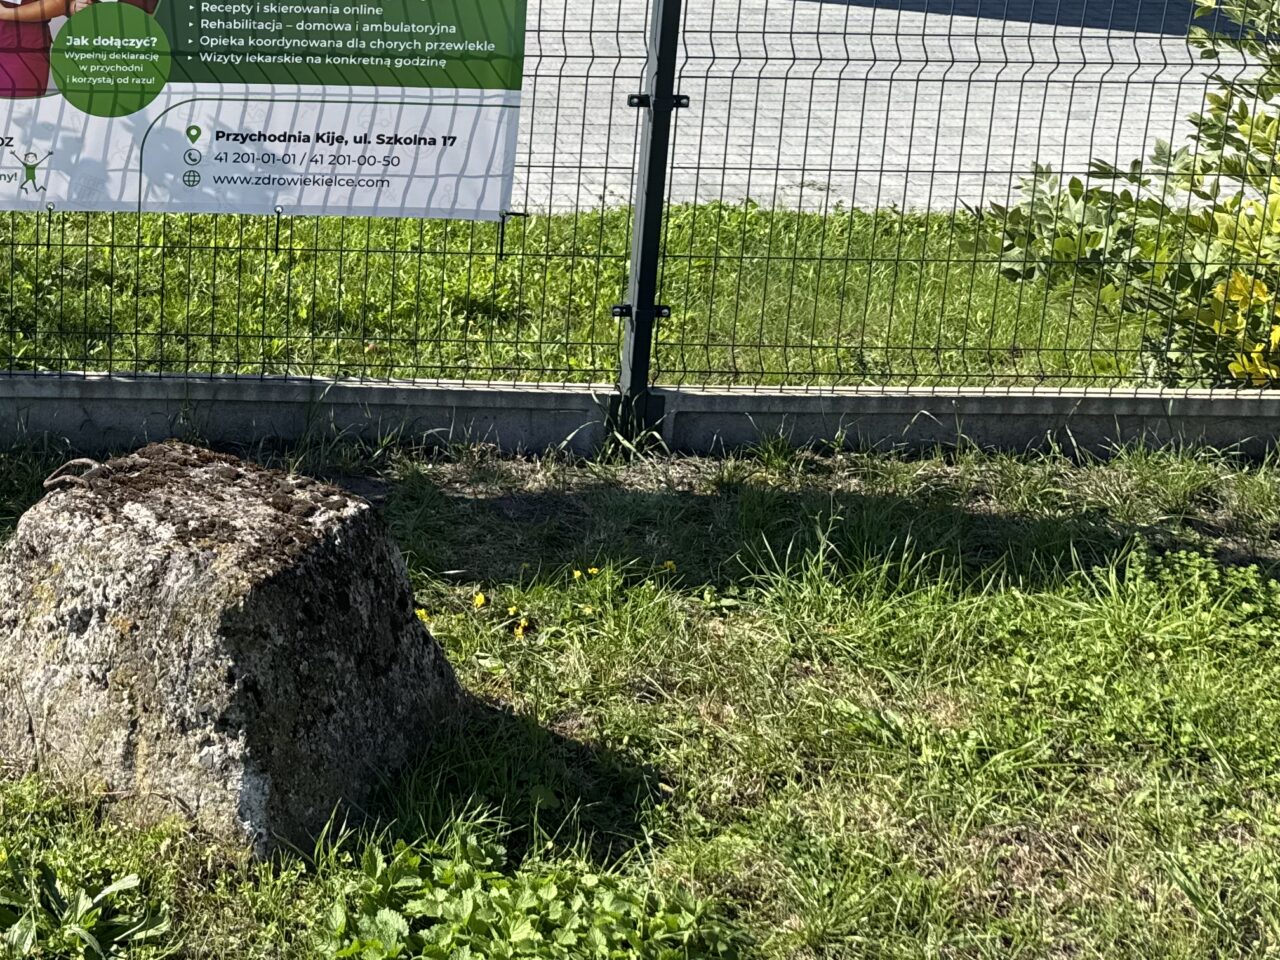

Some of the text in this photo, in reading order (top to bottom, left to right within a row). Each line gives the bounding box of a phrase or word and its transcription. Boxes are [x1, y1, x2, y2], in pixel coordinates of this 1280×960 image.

[201, 2, 384, 16] Recepty i skierowania online
[200, 19, 283, 32] Rehabilitacja
[295, 21, 352, 32] domowa
[356, 21, 359, 32] i
[362, 21, 457, 34] ambulatoryjna
[66, 36, 158, 48] Jak dołączyć?
[199, 35, 495, 53] Opieka koordynowana dla chorych przewlekle
[109, 52, 159, 62] deklarację
[199, 52, 447, 70] Wizyty lekarskie na konkretną godzinę
[90, 64, 144, 73] przychodni
[66, 75, 70, 83] i
[71, 76, 114, 85] korzystaj
[116, 76, 129, 84] od
[215, 130, 457, 147] Przychodnia Kije, ul. Szkolna 17
[213, 151, 401, 167] 41 201-01-01 / 41 201-00-50
[213, 173, 391, 189] www.zdrowiekielce.com
